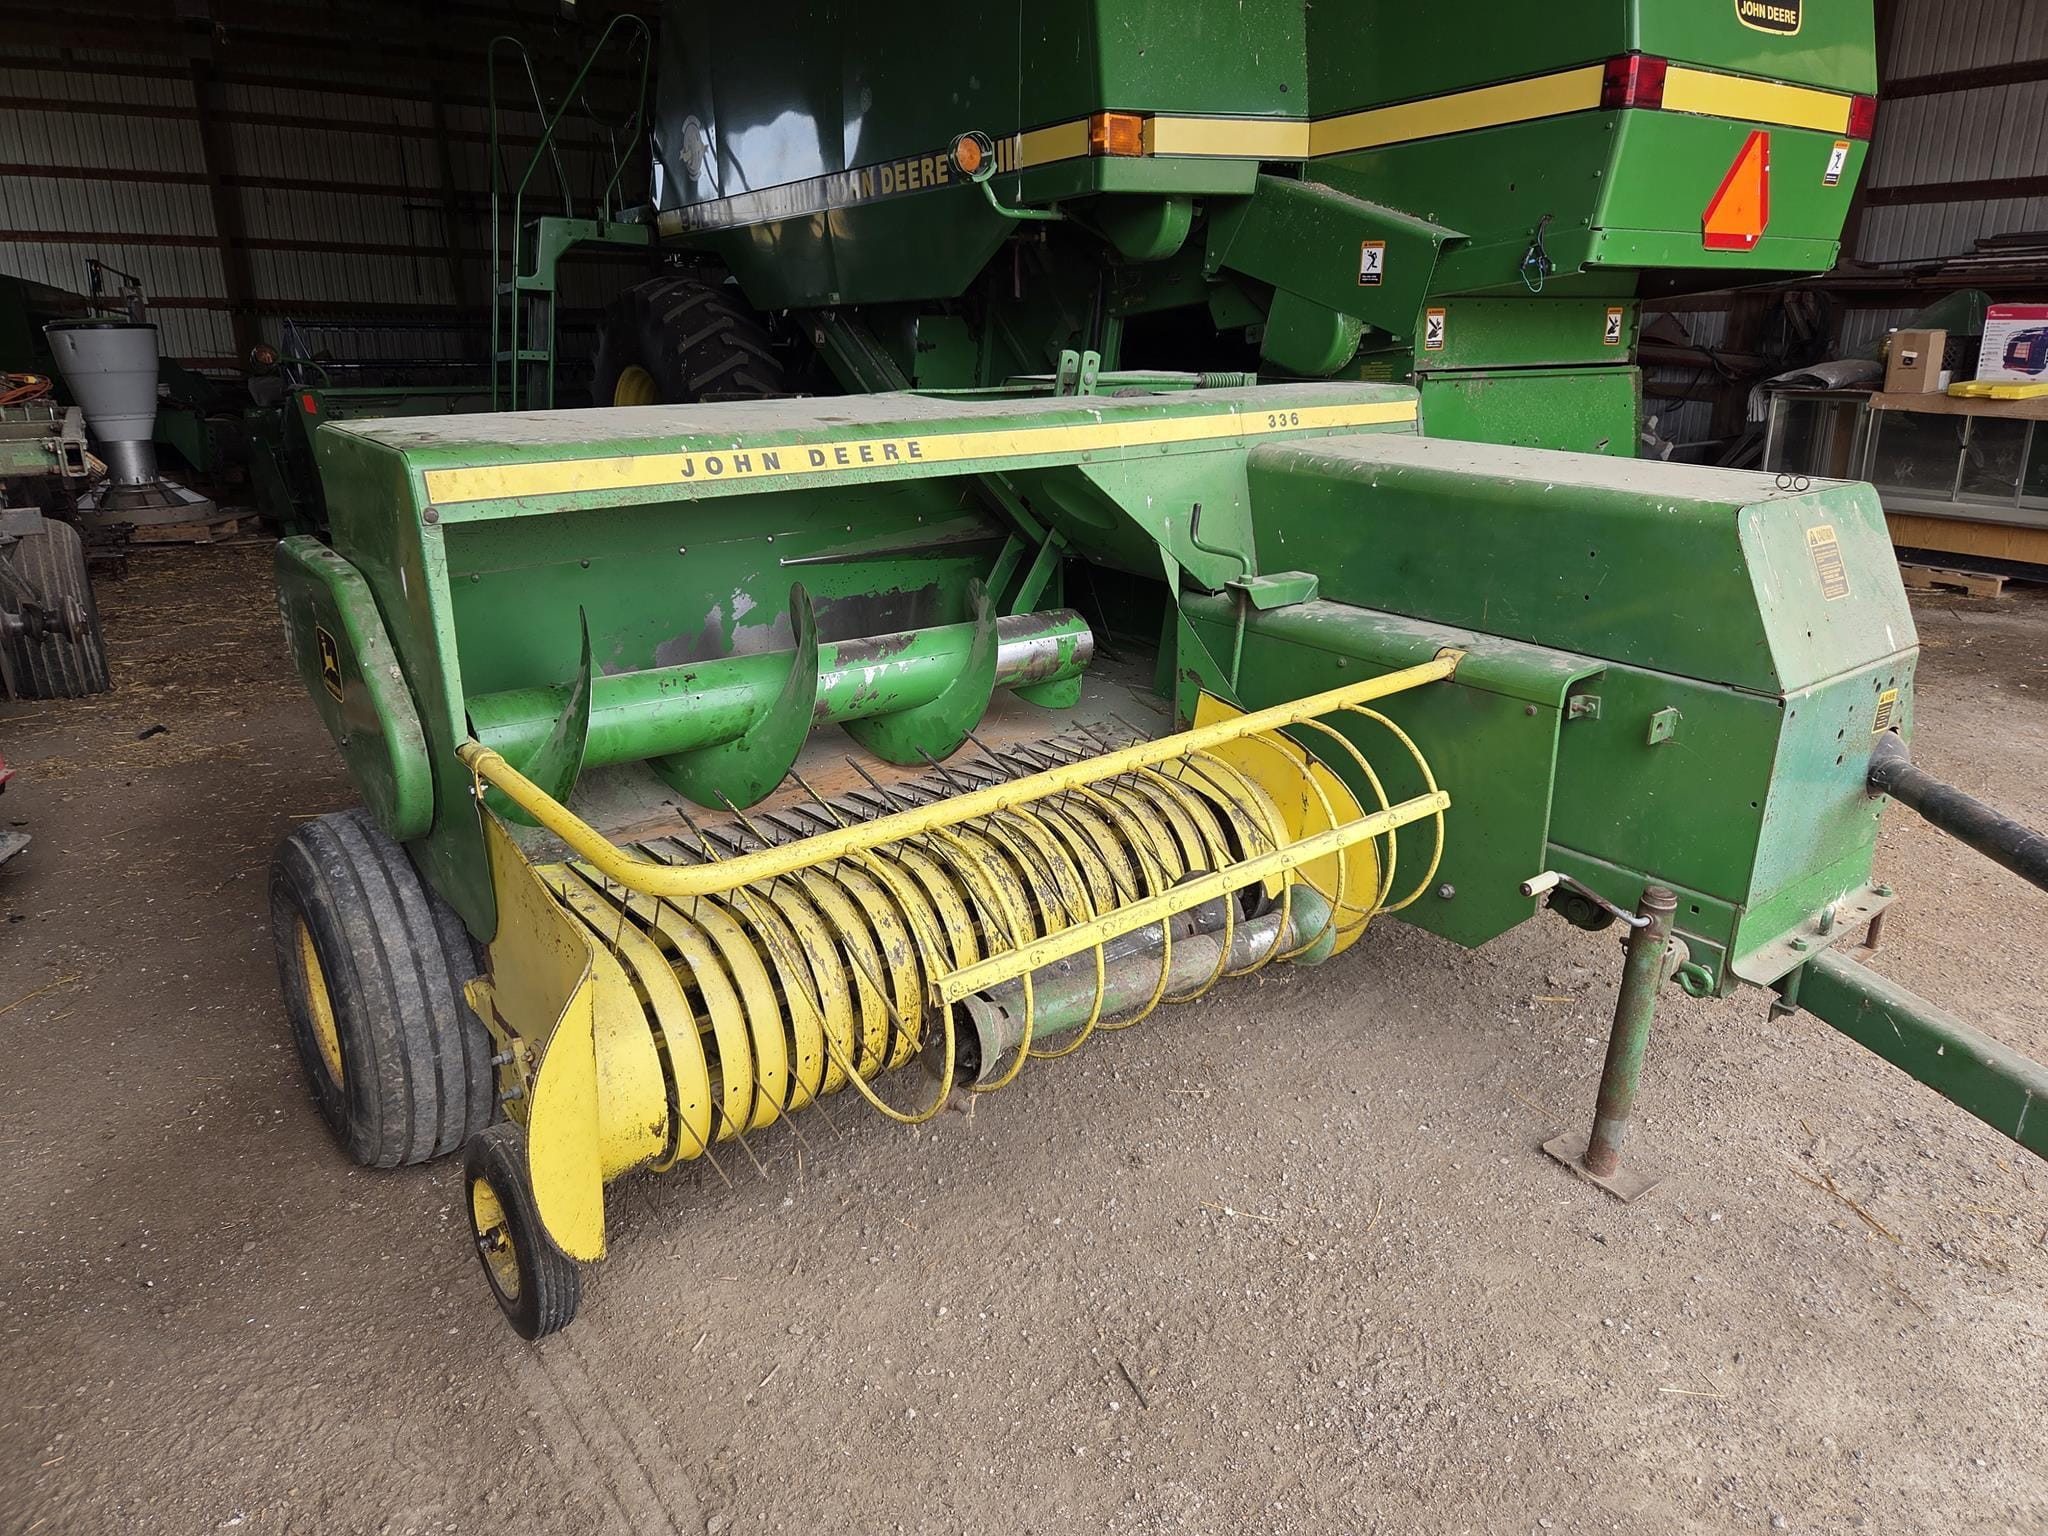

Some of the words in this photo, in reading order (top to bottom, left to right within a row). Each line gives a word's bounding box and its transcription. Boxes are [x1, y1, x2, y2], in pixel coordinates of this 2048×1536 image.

[1741, 1, 1766, 19] JOHN
[1767, 6, 1797, 25] DEERE
[880, 154, 949, 194] DEERE
[1268, 412, 1299, 428] 336
[681, 452, 781, 478] JOHN
[808, 441, 922, 467] DEERE
